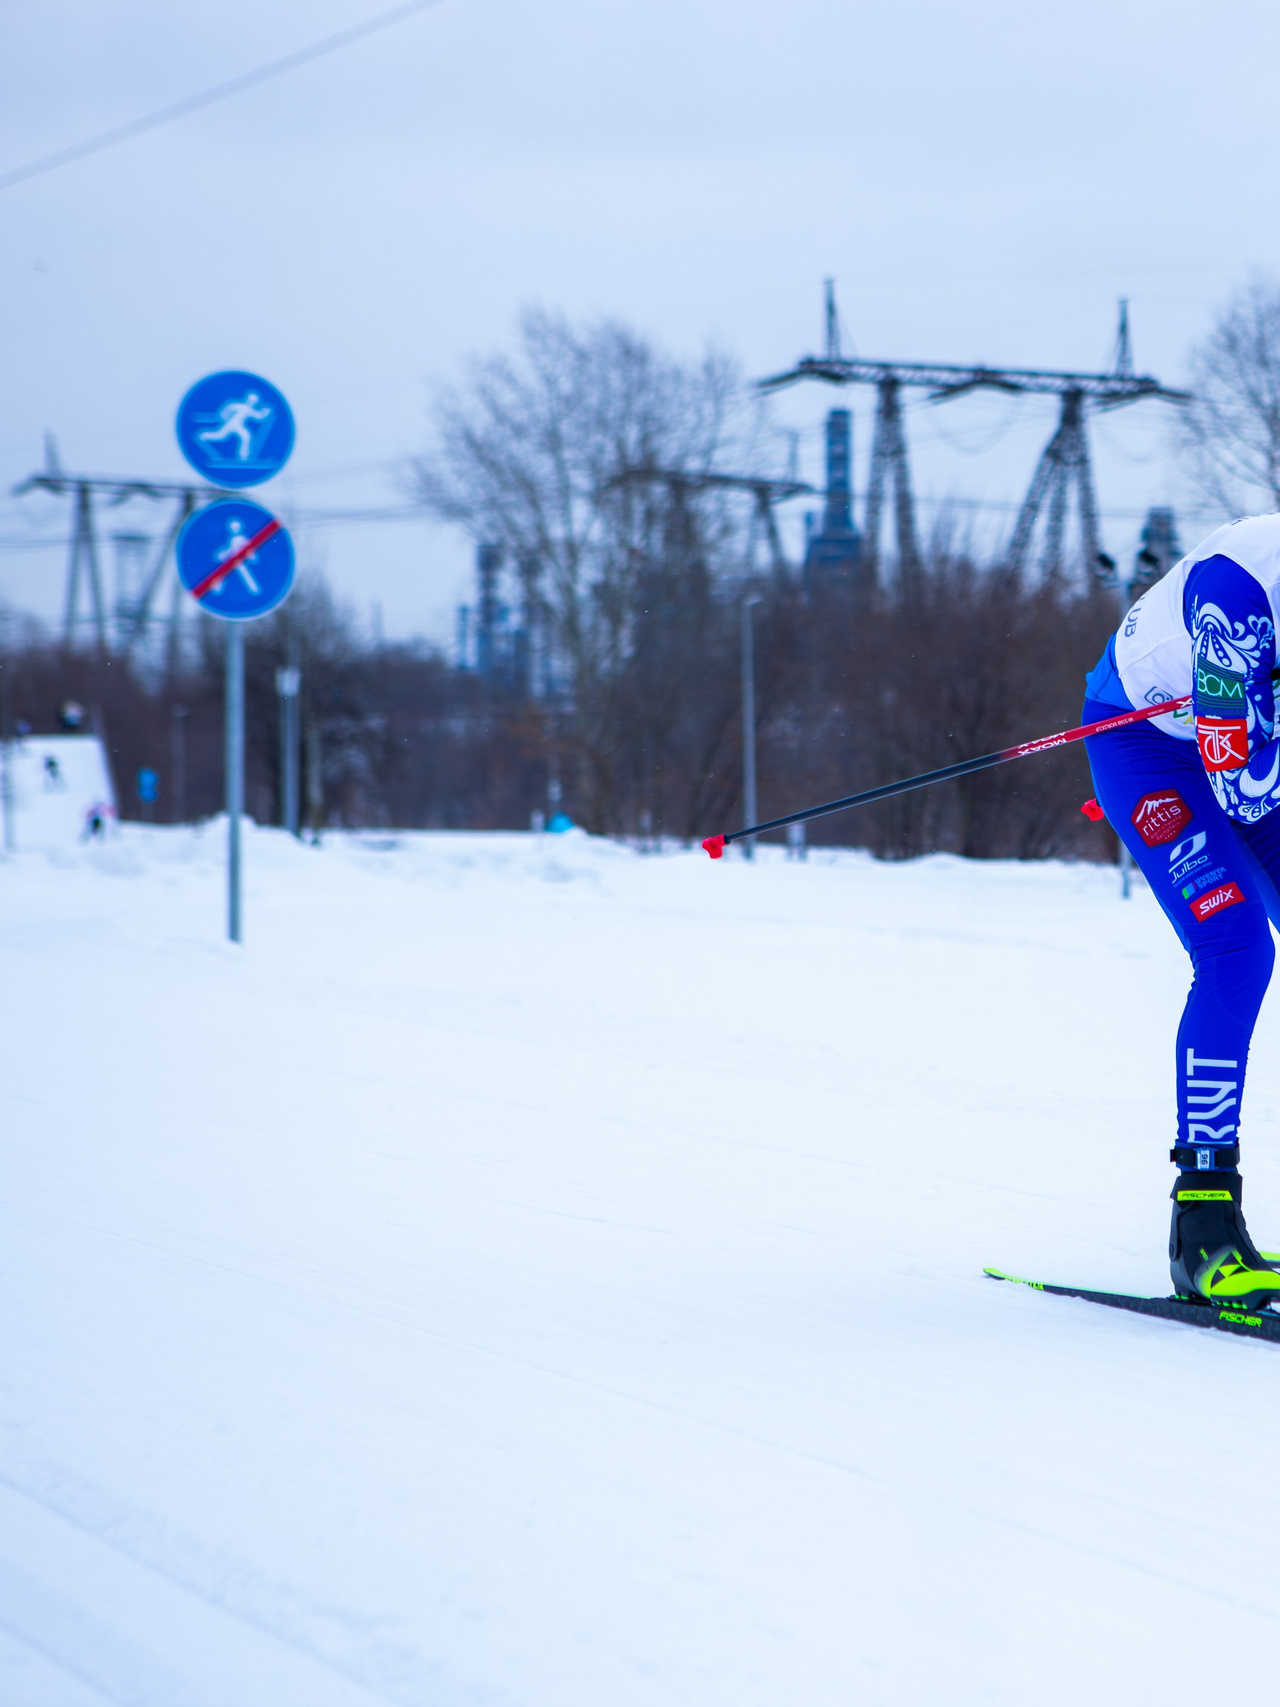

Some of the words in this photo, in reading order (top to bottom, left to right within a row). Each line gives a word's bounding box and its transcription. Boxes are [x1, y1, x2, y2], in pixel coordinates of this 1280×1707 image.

[1018, 738, 1067, 757] MOAX
[1142, 805, 1181, 836] rittis
[1172, 855, 1208, 884] Julbo
[1196, 873, 1225, 889] SPORT
[1186, 1048, 1238, 1144] RWT
[1218, 1311, 1263, 1328] FISCHER
